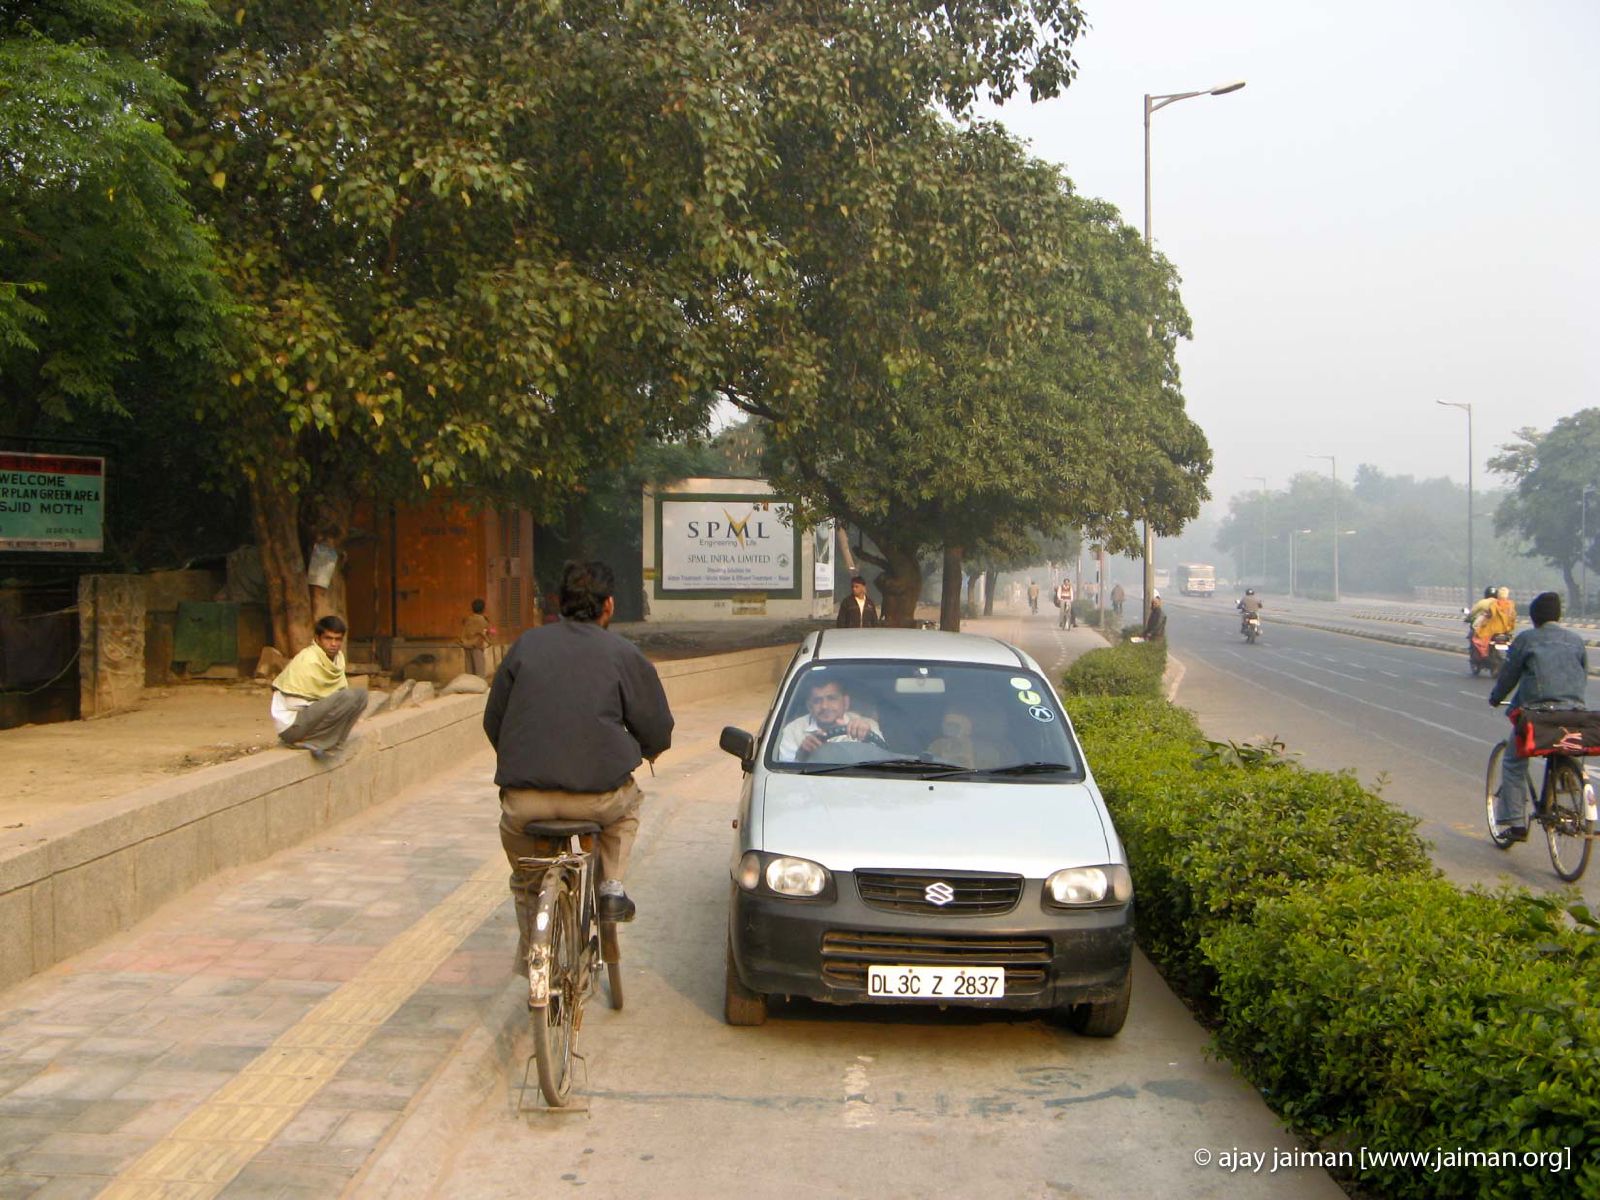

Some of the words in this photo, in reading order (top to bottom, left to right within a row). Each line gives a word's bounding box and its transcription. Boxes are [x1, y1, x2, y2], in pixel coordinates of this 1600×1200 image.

[0, 472, 65, 488] WELCOME
[11, 488, 38, 500] PLAN
[40, 489, 72, 500] GREEN
[74, 490, 100, 502] AREA
[40, 502, 84, 515] MOTH
[687, 521, 770, 539] SPML
[699, 539, 738, 548] Engineering
[687, 555, 707, 564] SPML
[738, 555, 771, 564] LIMITED
[931, 975, 943, 995] Z
[954, 975, 999, 995] 2837
